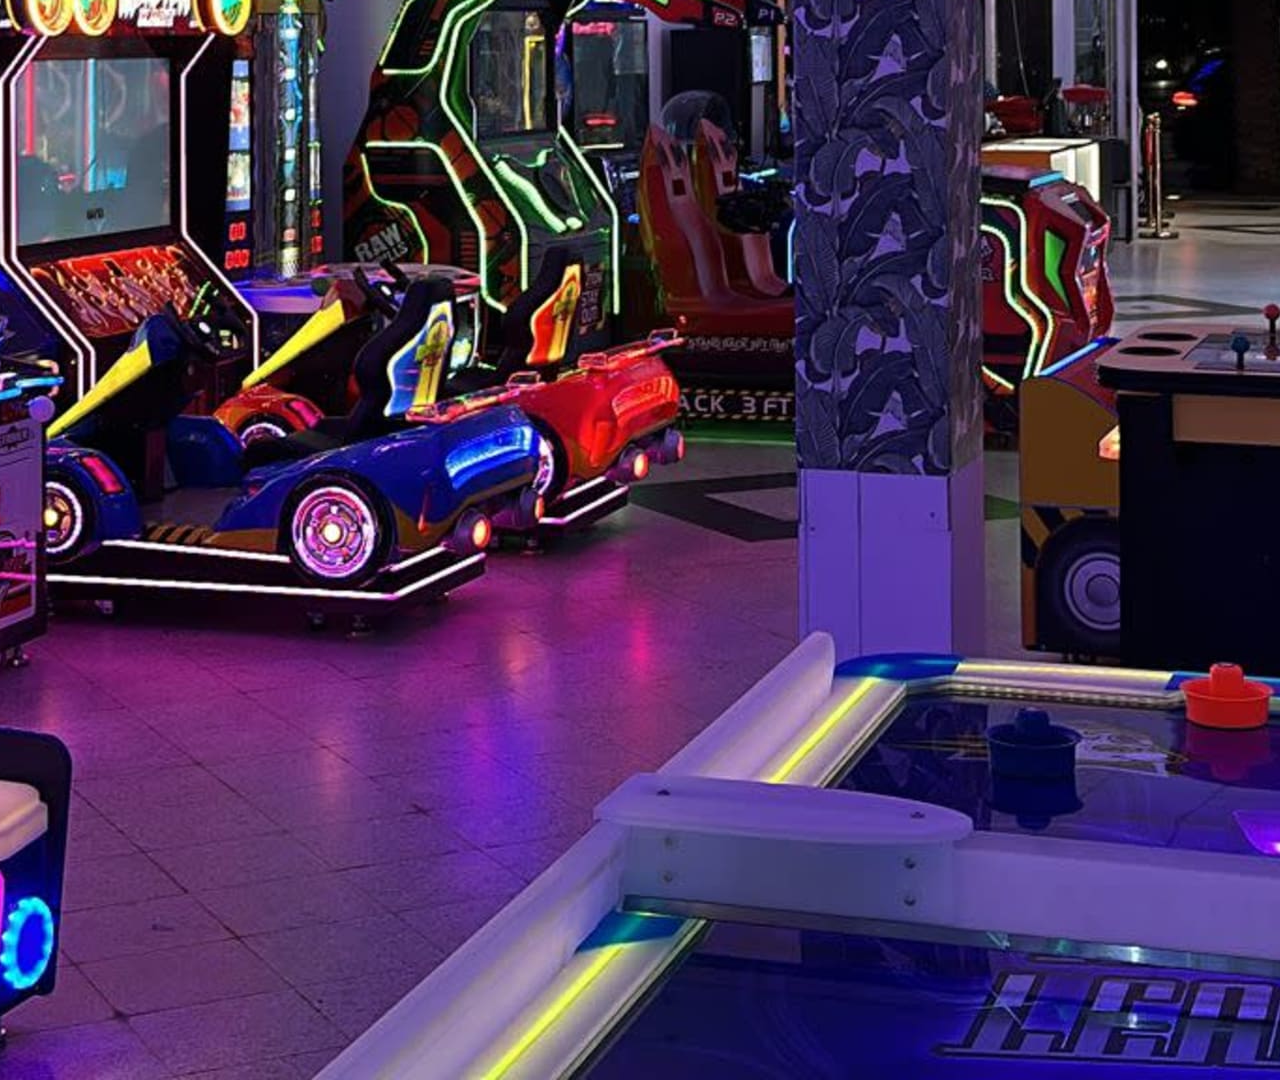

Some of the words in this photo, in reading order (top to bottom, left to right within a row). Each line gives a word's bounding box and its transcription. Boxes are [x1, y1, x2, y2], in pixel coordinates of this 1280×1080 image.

[714, 12, 738, 25] P2
[758, 8, 775, 21] P1
[354, 222, 401, 262] RAW
[679, 394, 725, 413] ACK
[741, 395, 757, 414] 3
[763, 397, 793, 415] FT
